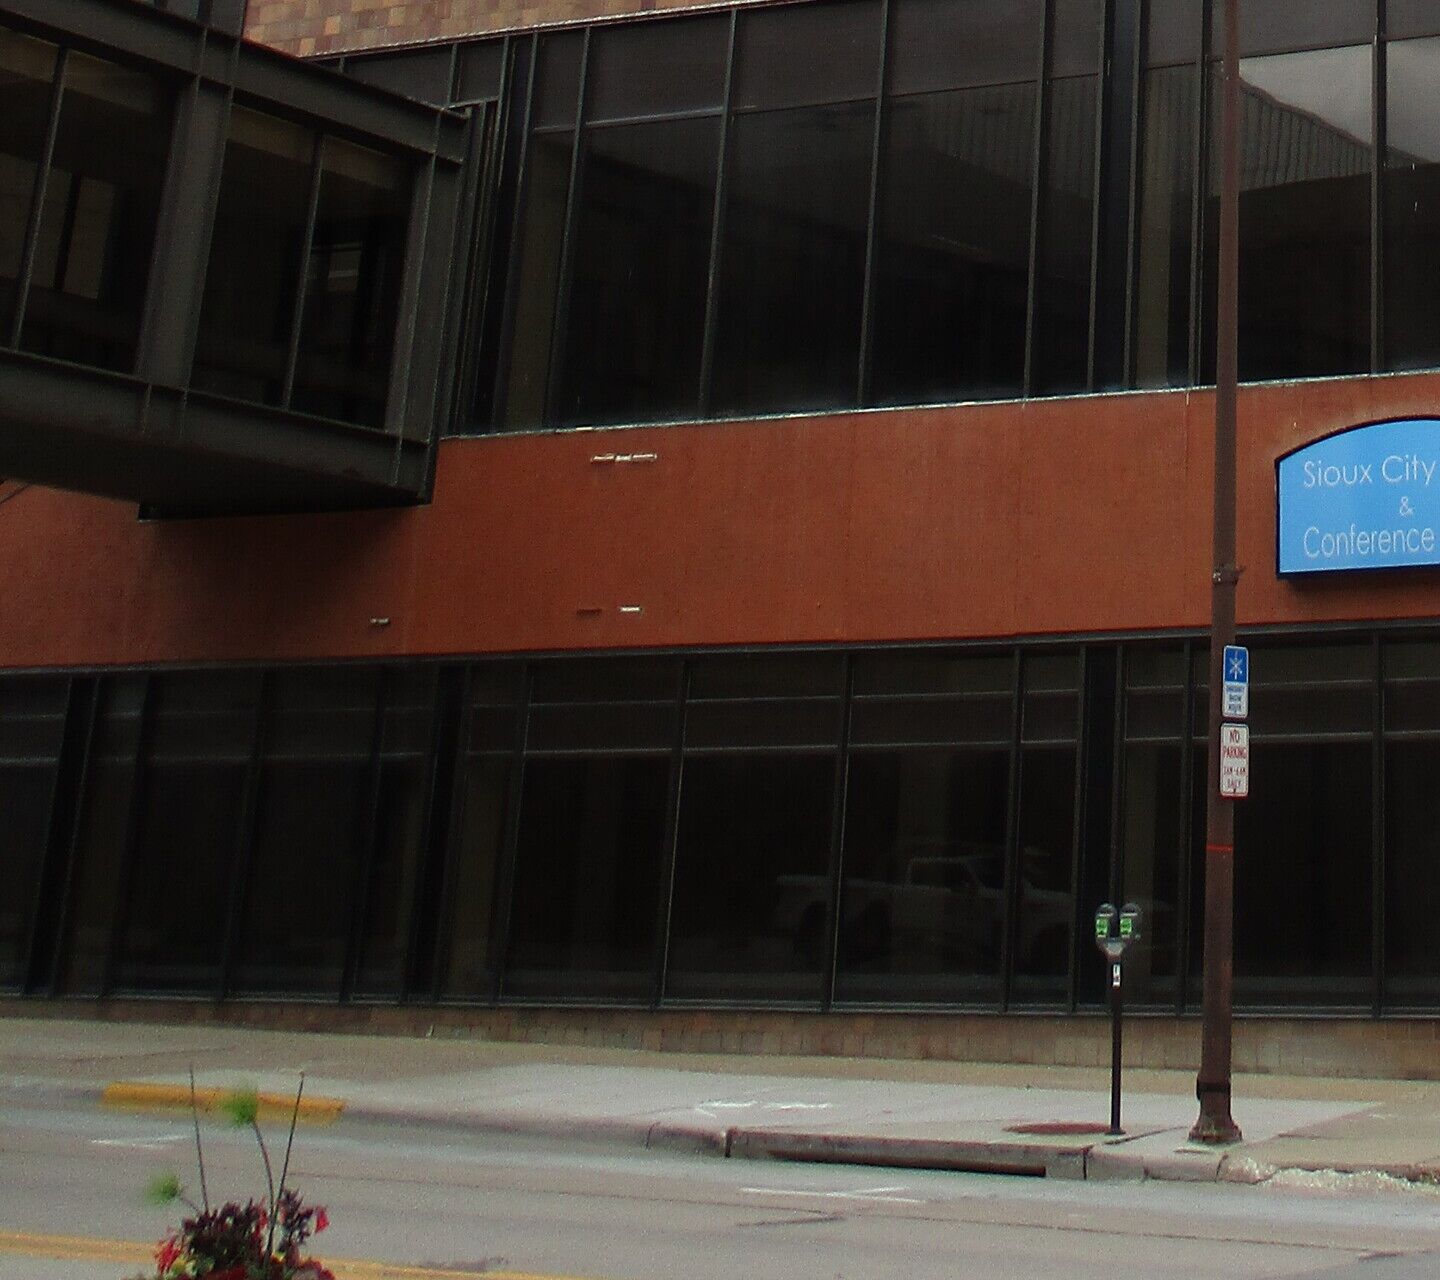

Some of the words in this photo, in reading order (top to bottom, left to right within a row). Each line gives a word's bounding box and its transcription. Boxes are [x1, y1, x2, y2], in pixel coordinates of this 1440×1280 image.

[1303, 459, 1373, 489] Sioux
[1381, 453, 1437, 485] City
[1398, 495, 1413, 518] &
[1303, 523, 1436, 559] Conference
[1229, 729, 1240, 743] NO
[1223, 746, 1247, 759] PARKING
